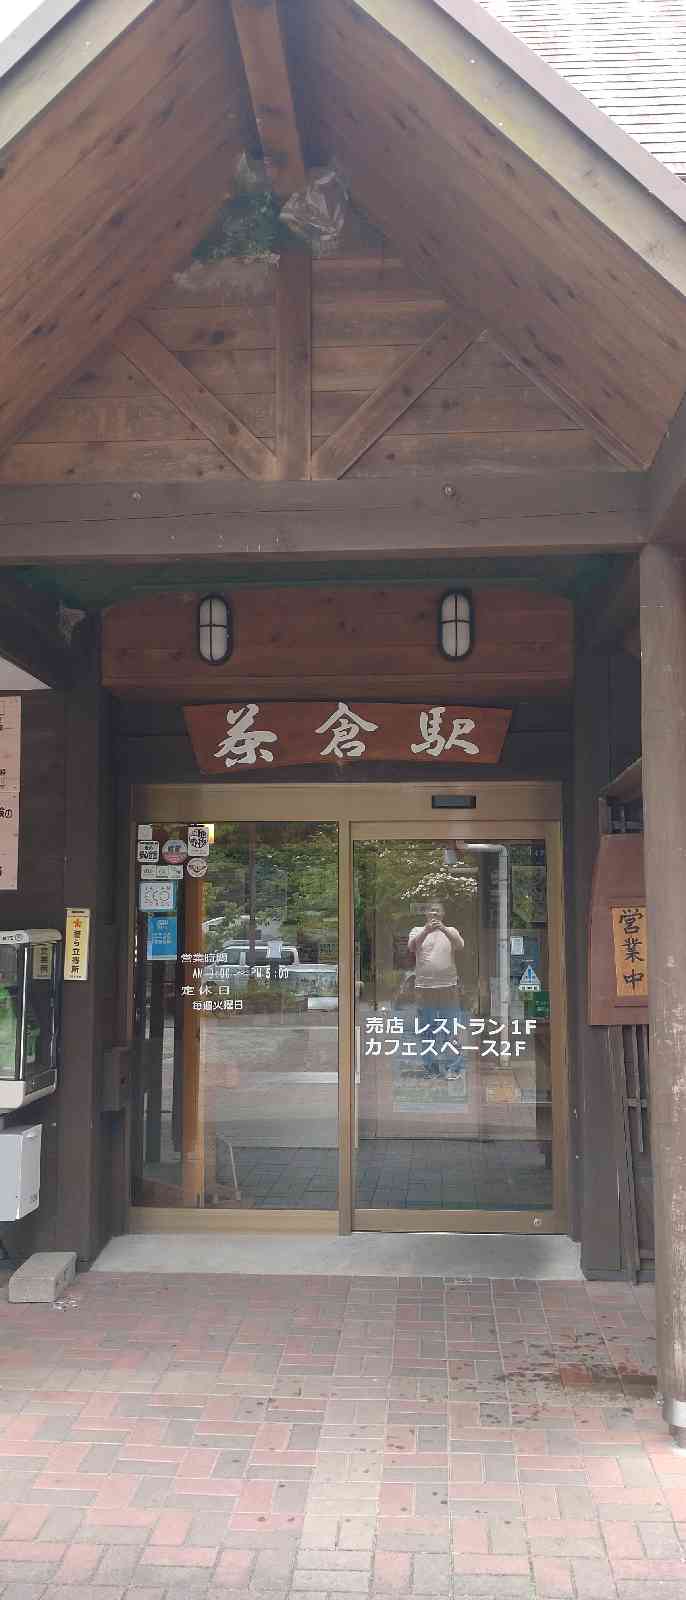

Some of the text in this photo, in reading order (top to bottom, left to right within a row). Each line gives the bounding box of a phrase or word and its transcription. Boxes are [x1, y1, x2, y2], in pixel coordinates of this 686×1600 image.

[214, 702, 480, 768] 茶倉駅
[181, 953, 228, 963] 営業時間
[618, 908, 645, 990] 営業中
[192, 1000, 243, 1011] 毎週火曜日
[365, 1016, 404, 1034] 売店
